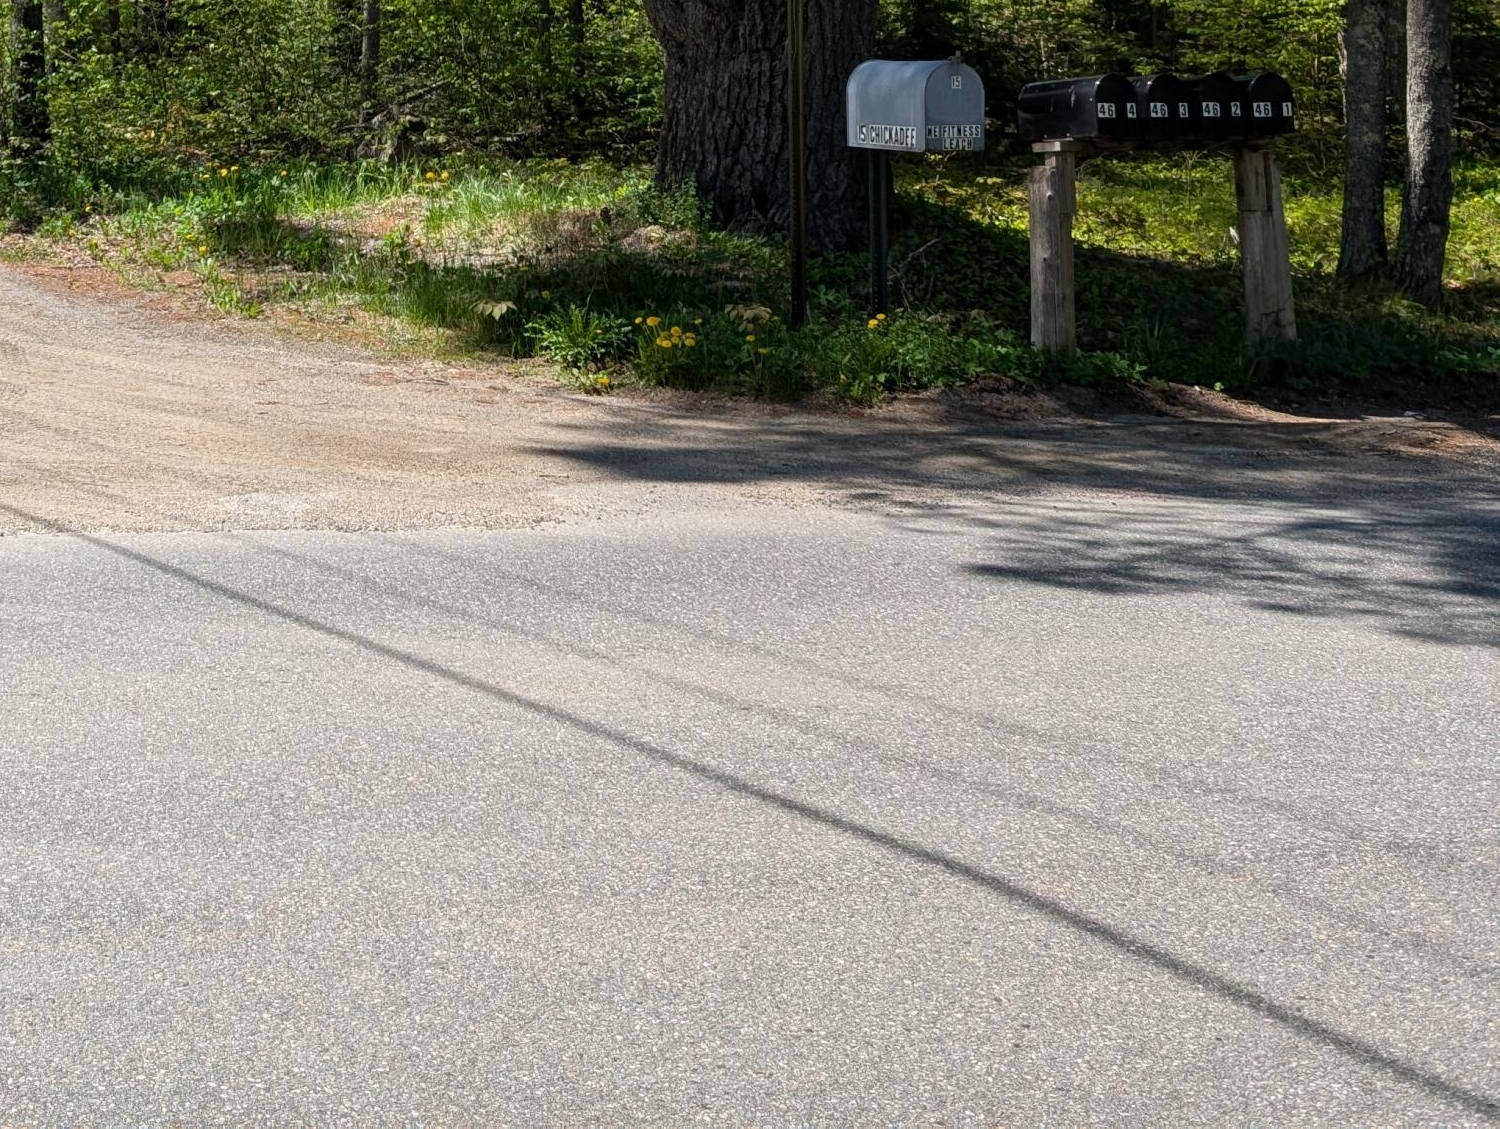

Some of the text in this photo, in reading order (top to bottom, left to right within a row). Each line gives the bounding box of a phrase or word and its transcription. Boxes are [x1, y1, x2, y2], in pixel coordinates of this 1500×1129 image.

[952, 77, 961, 88] 15
[1099, 104, 1115, 117] 46
[1128, 104, 1135, 116] 4
[1151, 104, 1167, 116] 46
[1180, 104, 1187, 116] 3
[1204, 103, 1219, 116] 46
[1232, 103, 1240, 116] 2
[1255, 103, 1271, 116] 46
[858, 124, 916, 147] 15 CHICKADEE
[943, 125, 980, 137] FITNESS
[944, 138, 972, 150] LEACH
